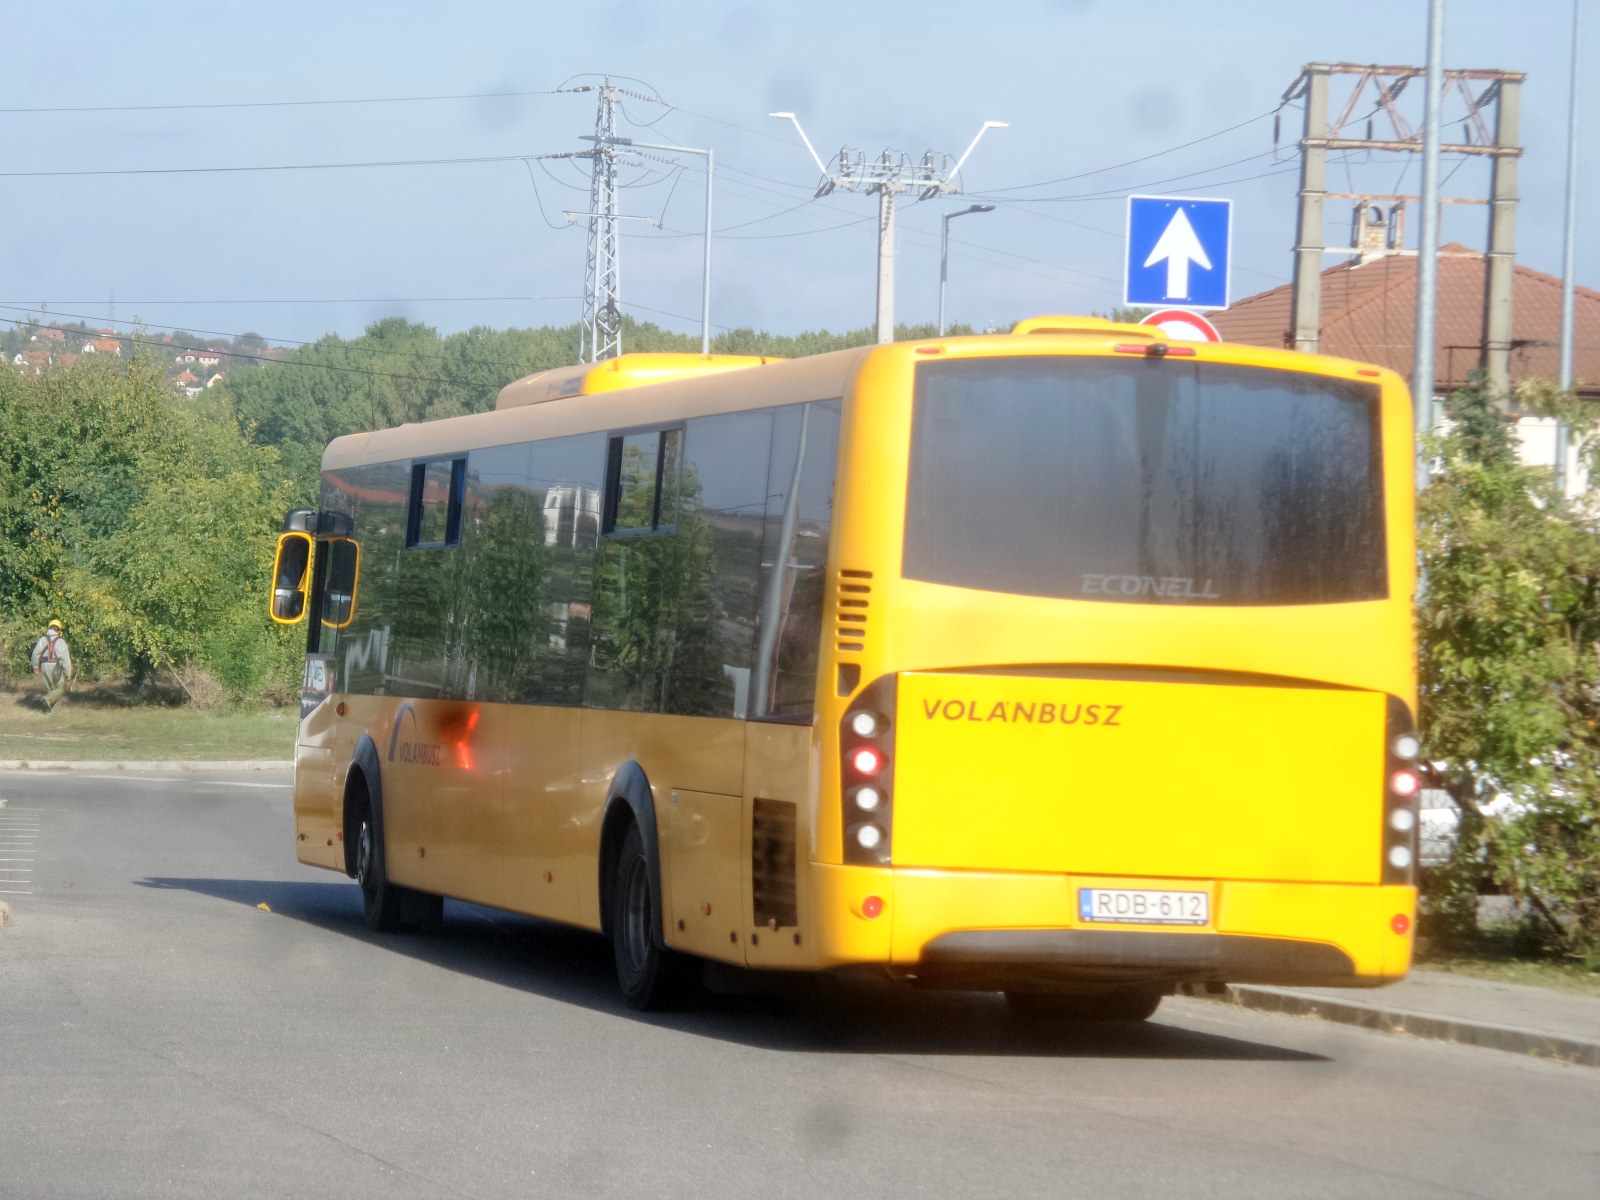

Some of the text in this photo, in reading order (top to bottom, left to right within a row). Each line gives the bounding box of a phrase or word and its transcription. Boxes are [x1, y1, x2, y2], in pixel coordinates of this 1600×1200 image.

[1080, 574, 1219, 598] ECONELL
[923, 699, 1123, 726] VOLÁNBUSZ
[1098, 893, 1201, 916] RDB-612
